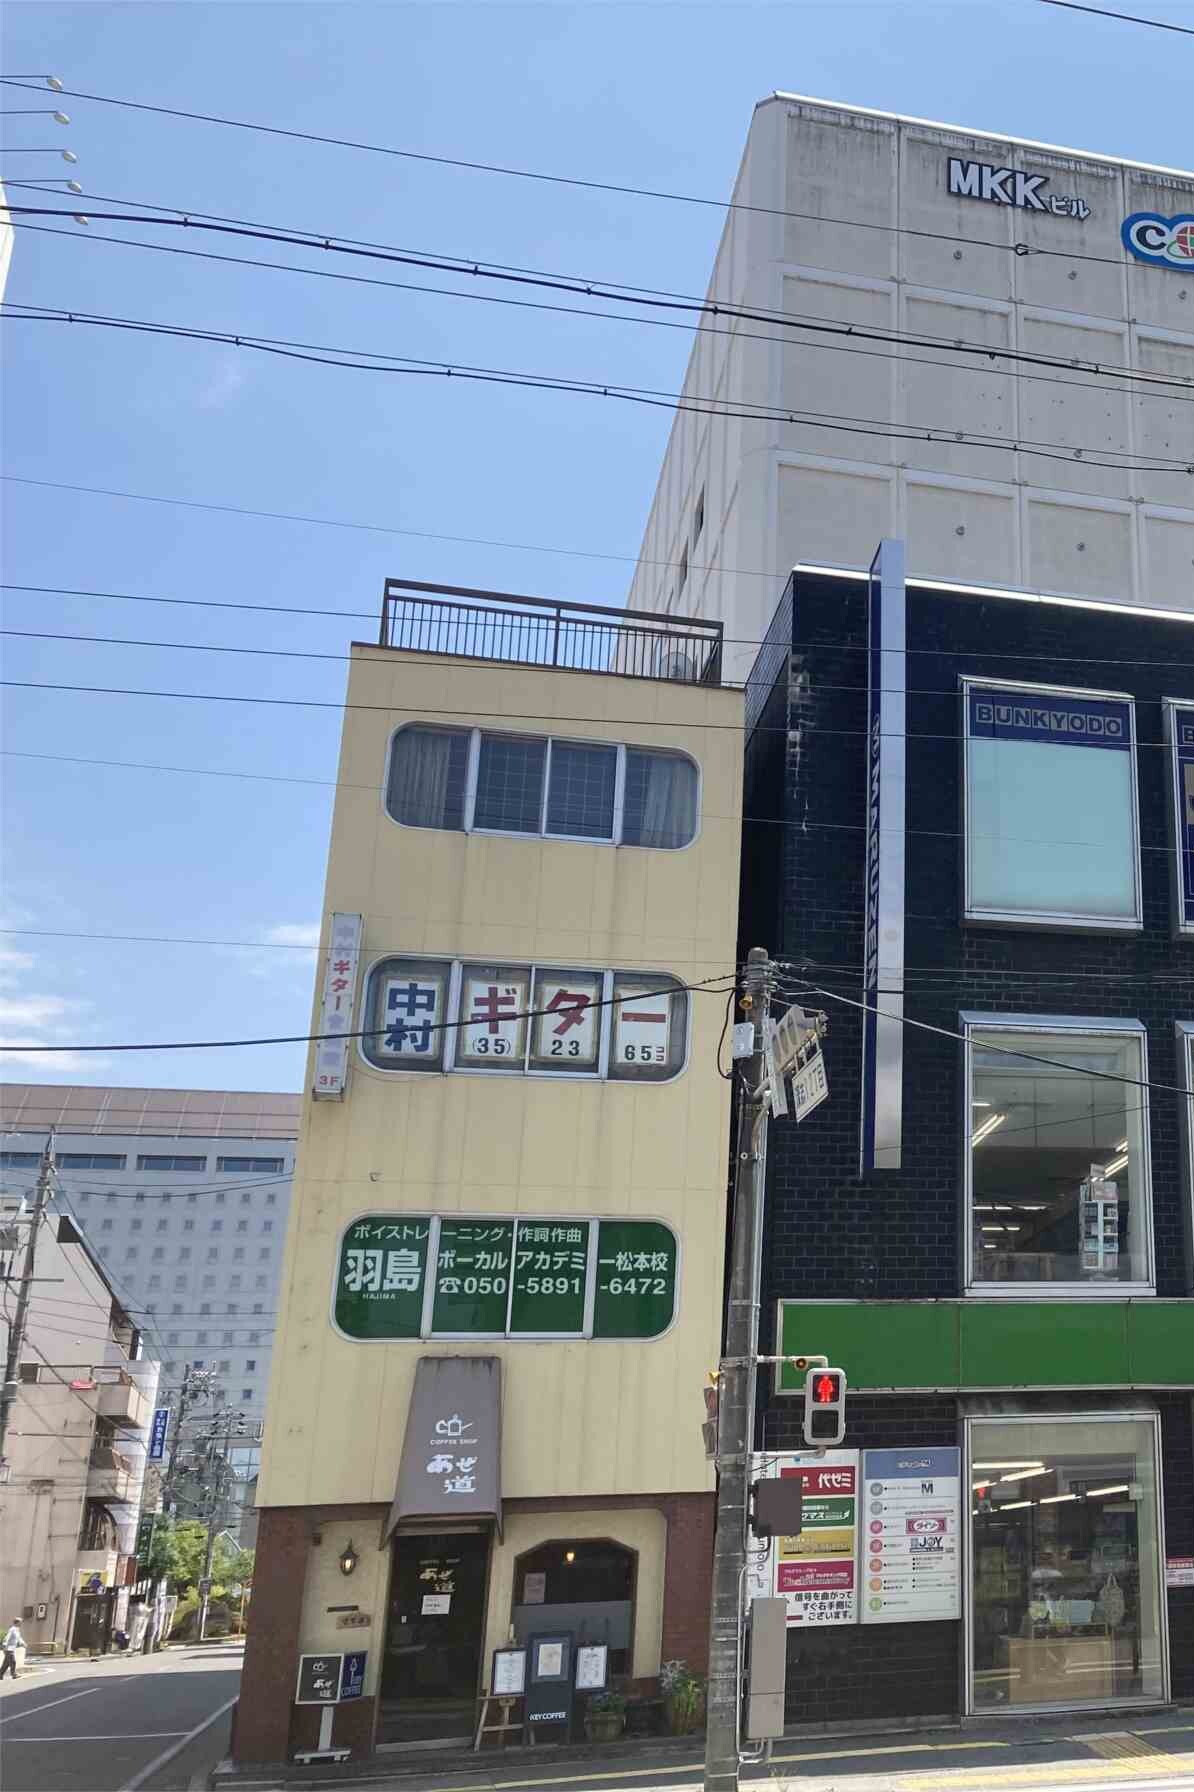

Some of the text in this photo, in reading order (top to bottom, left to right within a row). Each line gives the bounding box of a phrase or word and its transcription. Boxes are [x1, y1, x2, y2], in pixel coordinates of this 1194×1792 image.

[976, 703, 1122, 736] BUNKYODO
[384, 981, 437, 1053] 中村
[473, 985, 667, 1036] ギター
[551, 1039, 581, 1057] 23
[319, 1075, 340, 1087] 3F
[344, 1248, 421, 1292] 羽島
